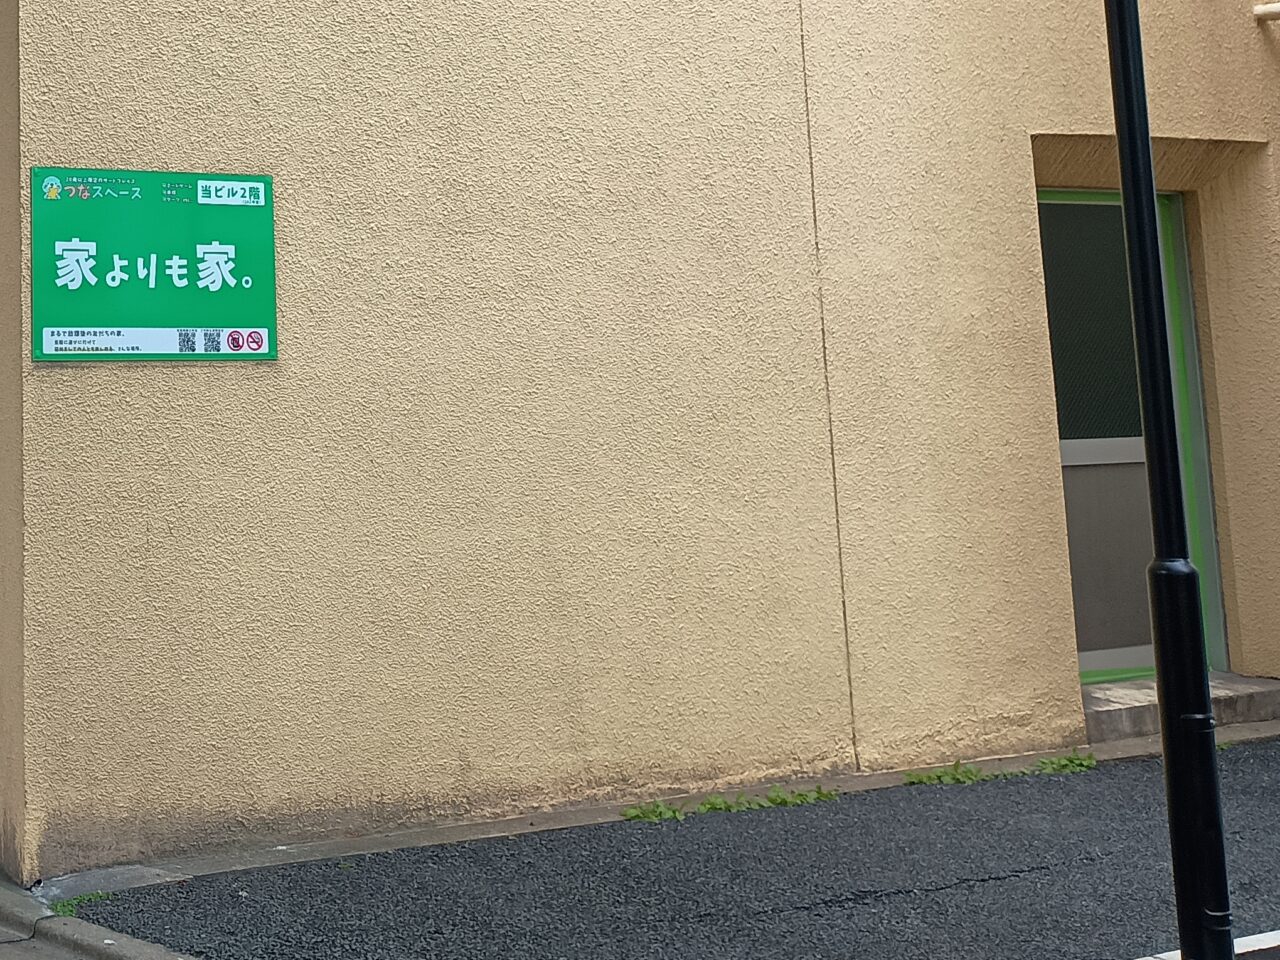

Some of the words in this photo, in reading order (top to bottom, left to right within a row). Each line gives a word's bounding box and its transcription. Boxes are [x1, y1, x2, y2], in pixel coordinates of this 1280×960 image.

[201, 184, 261, 201] 当ビル2階
[54, 237, 253, 292] 家よりも家。
